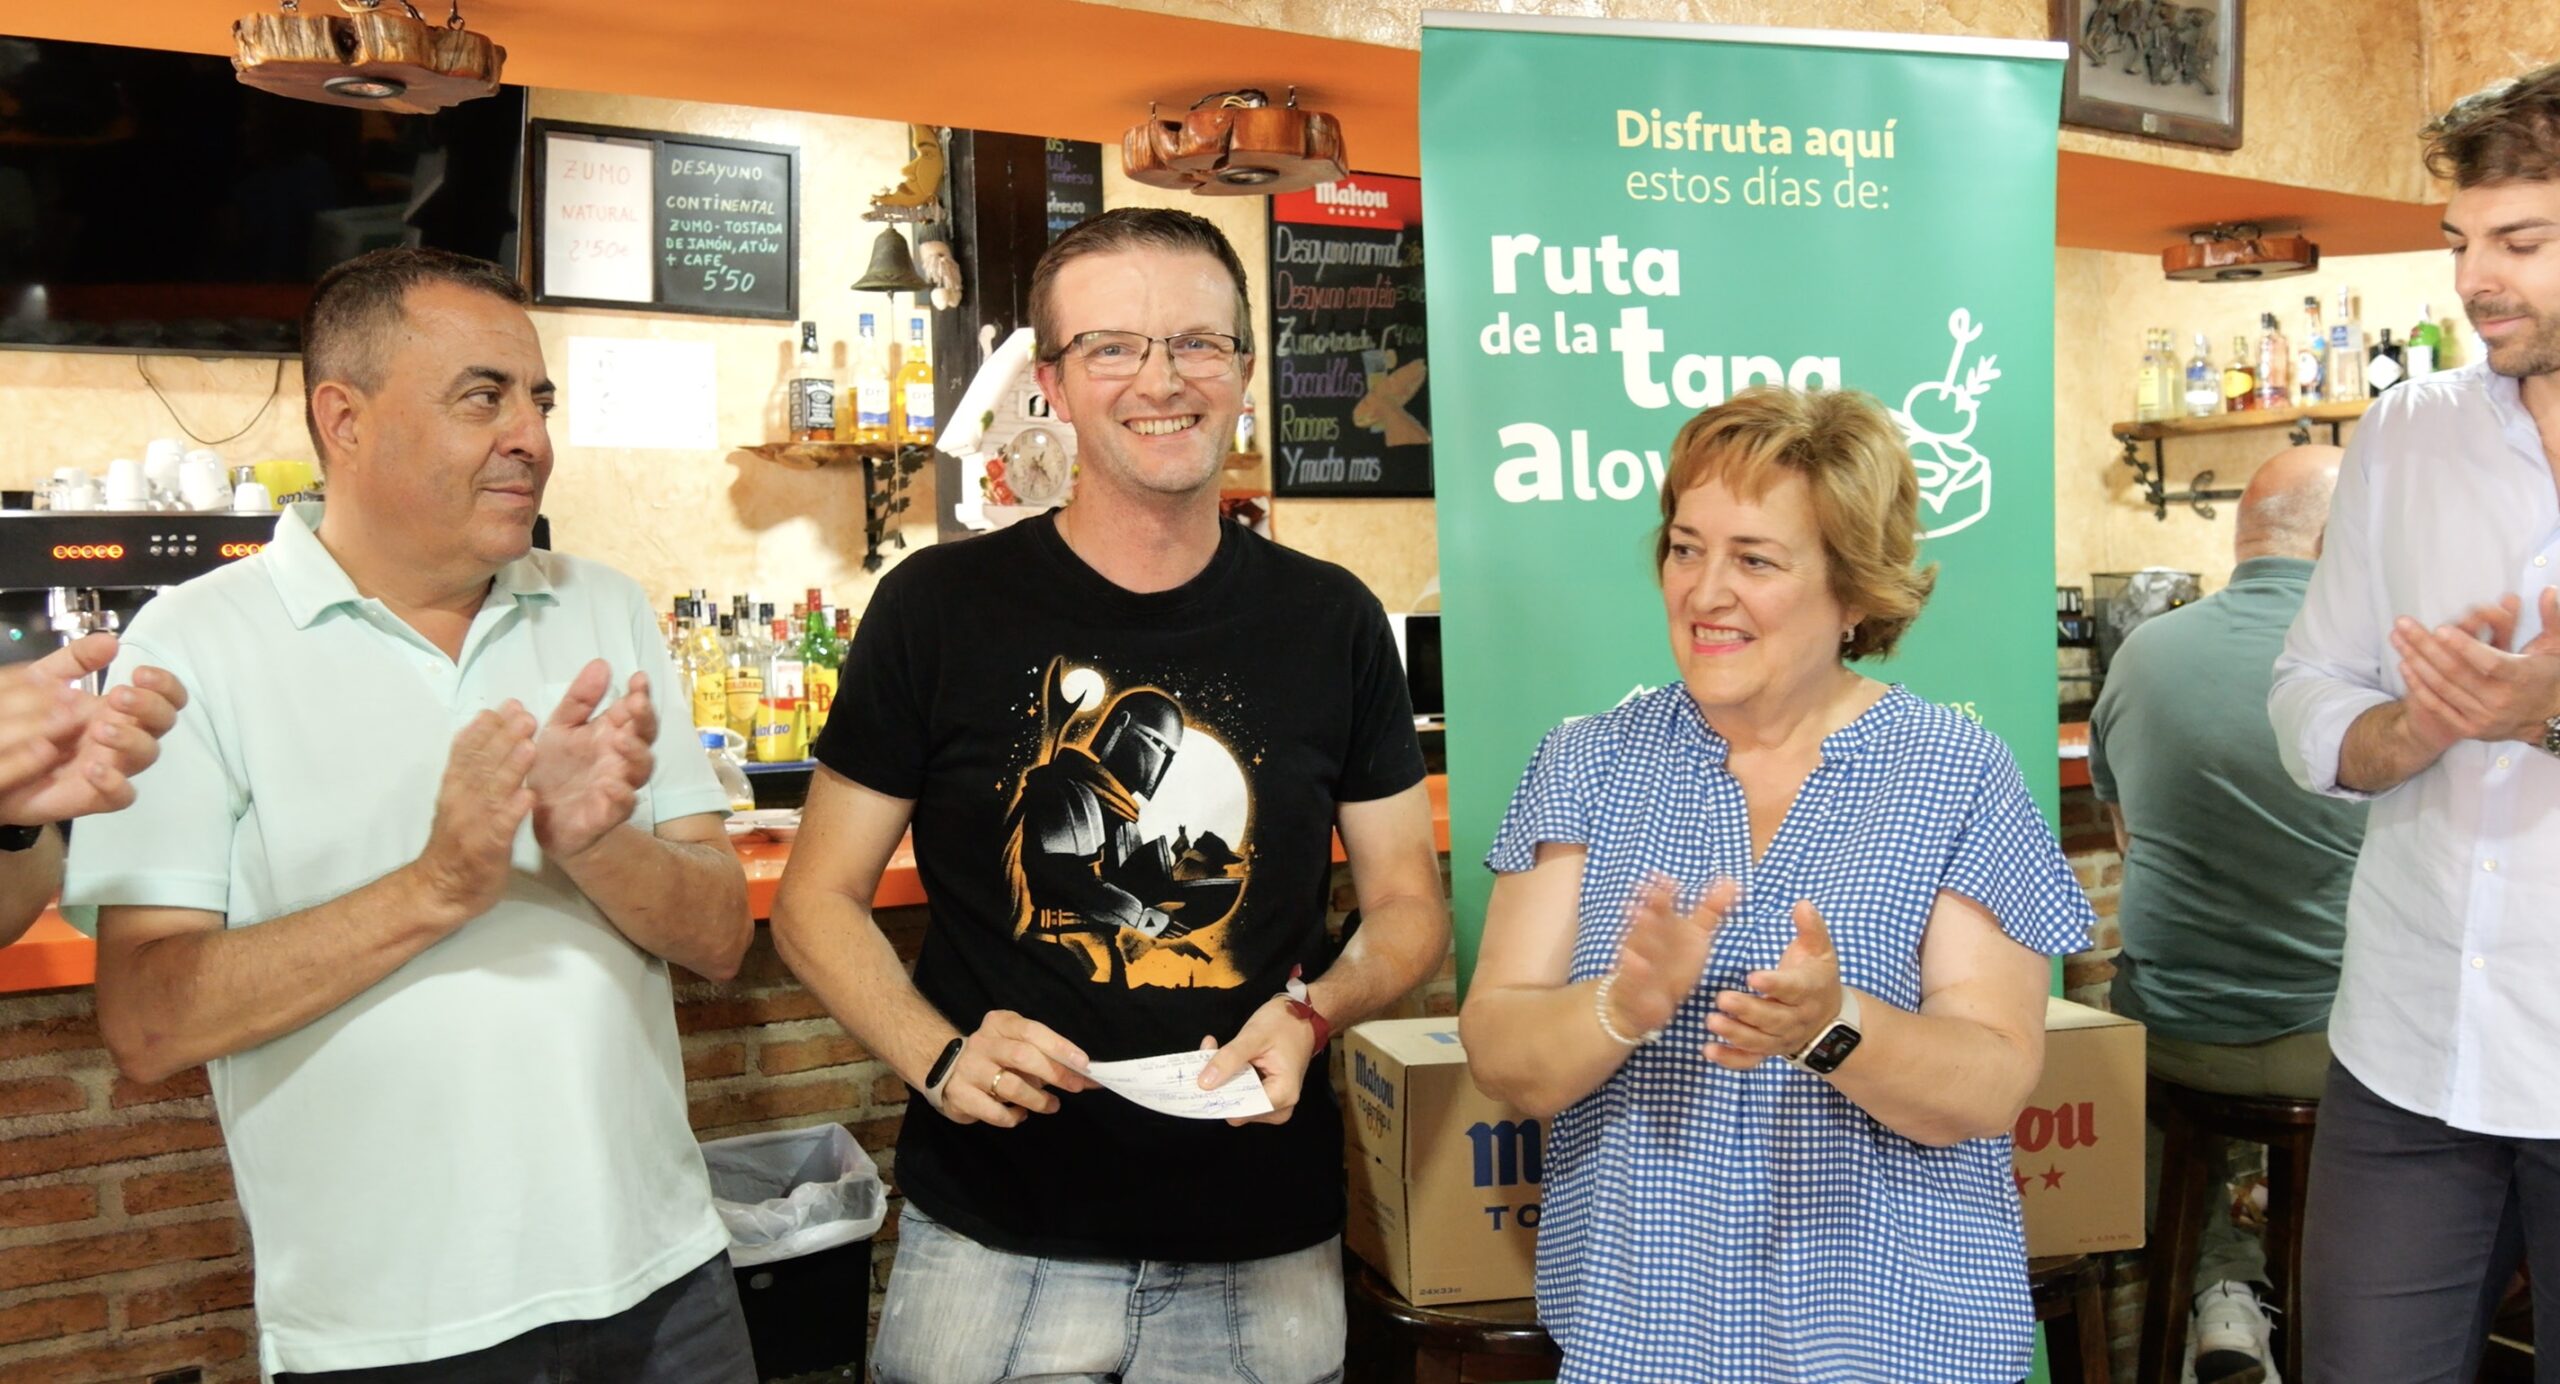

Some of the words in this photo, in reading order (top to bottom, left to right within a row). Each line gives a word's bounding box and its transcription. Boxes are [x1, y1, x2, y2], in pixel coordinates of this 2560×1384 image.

[1616, 108, 1792, 155] Disfruta
[1804, 118, 1898, 168] aquí
[561, 158, 632, 186] ZUMO
[670, 158, 763, 185] DESAYUNO
[1625, 167, 1732, 205] estos
[1742, 165, 1823, 208] días
[1833, 167, 1891, 210] de:
[560, 203, 639, 224] NATURAL
[665, 193, 776, 216] CONTINENTAL
[1314, 180, 1389, 209] Mahou
[665, 236, 685, 250] DE
[739, 238, 779, 254] ATÚN
[669, 219, 712, 233] ZUMO
[724, 219, 783, 235] TOSTADA
[1276, 225, 1349, 282] Desayuno
[1350, 231, 1403, 268] normal
[1490, 233, 1681, 296] ruta
[1276, 270, 1345, 326] Desayuno
[1346, 272, 1396, 325] completo
[1479, 310, 1541, 356] de
[1553, 310, 1598, 356] la
[1280, 357, 1365, 399] Bocadillos
[1279, 403, 1340, 443] Raciones
[1355, 1048, 1395, 1111] Mahou
[2013, 1101, 2099, 1154] ou
[1484, 1203, 1542, 1232] TO
